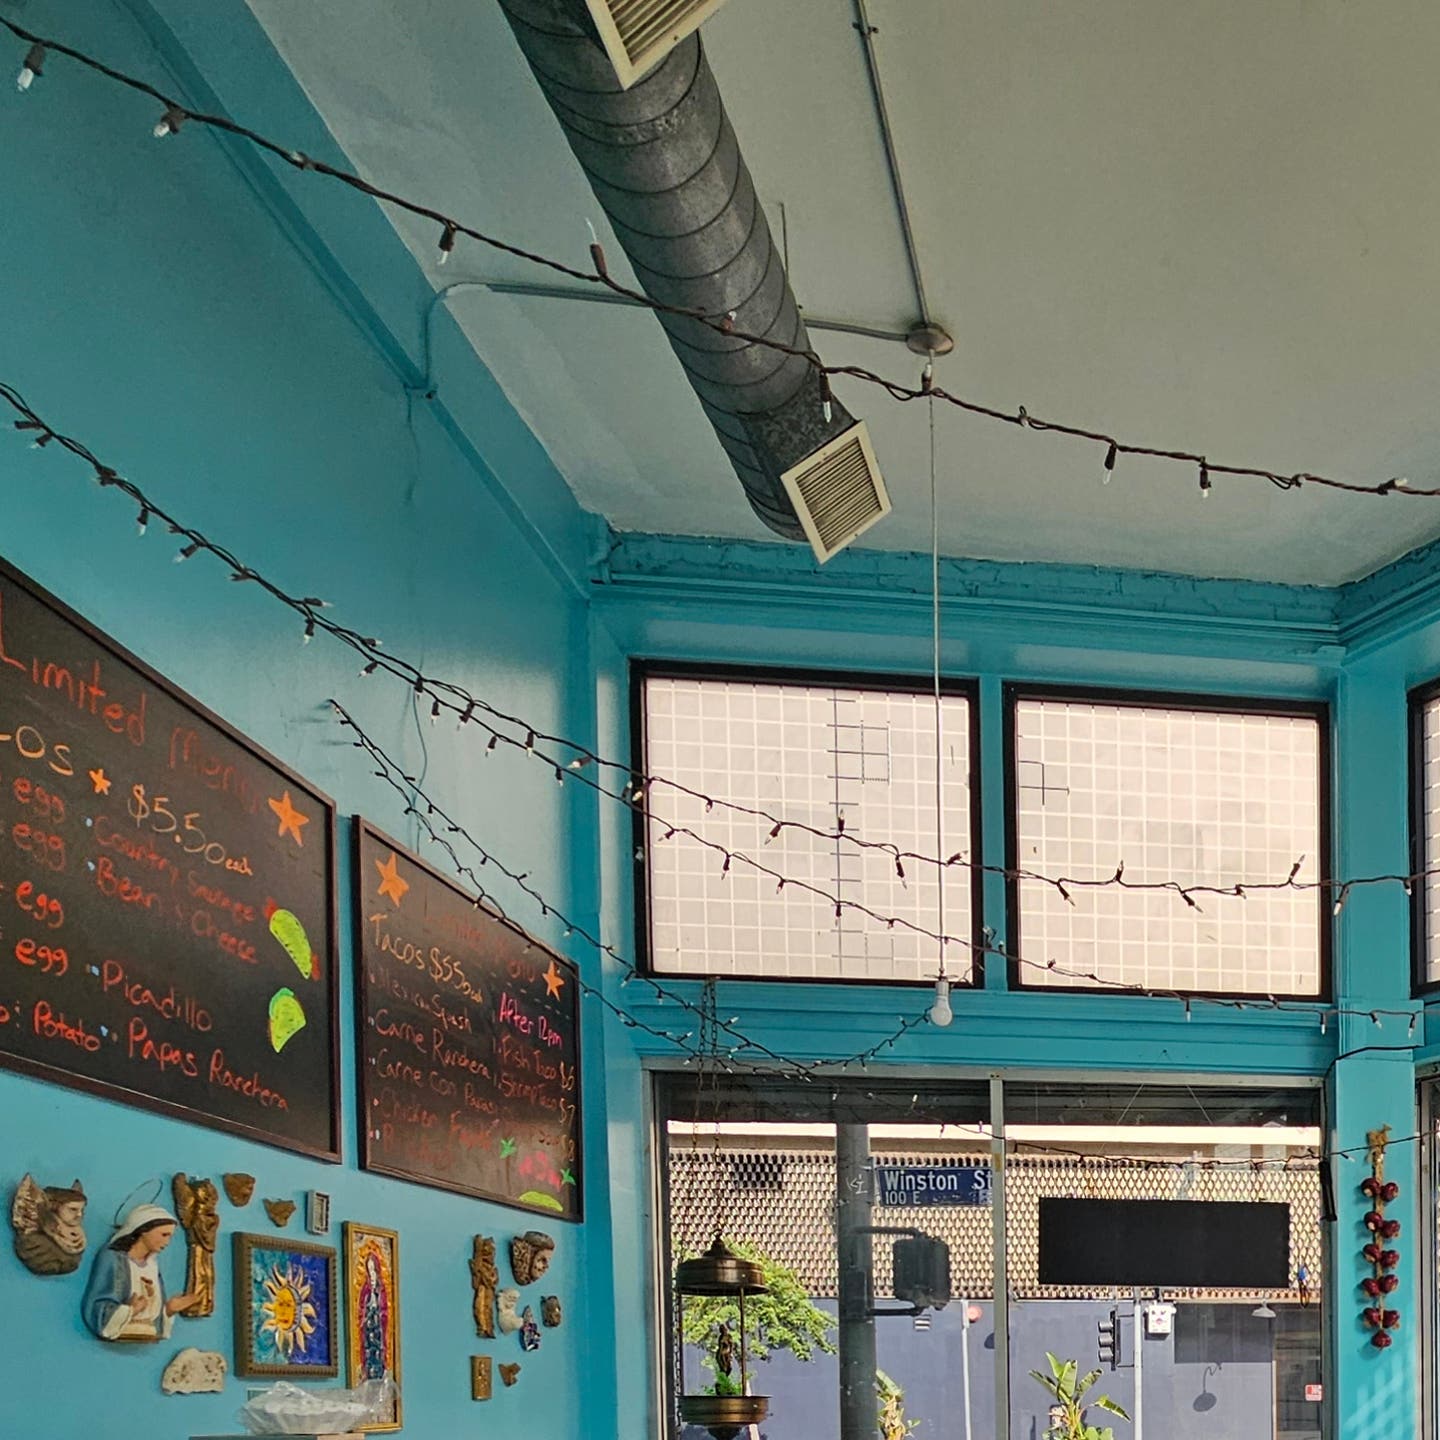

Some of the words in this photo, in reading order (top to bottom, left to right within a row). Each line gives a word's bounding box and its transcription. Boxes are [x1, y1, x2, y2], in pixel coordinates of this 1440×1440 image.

[16, 881, 65, 929] egg
[15, 939, 69, 977] egg
[102, 959, 213, 1032] Picadillo
[33, 1000, 101, 1052] Potato
[883, 1170, 958, 1191] Winston
[973, 1170, 993, 1190] St
[885, 1190, 907, 1205] 100
[912, 1190, 922, 1205] E
